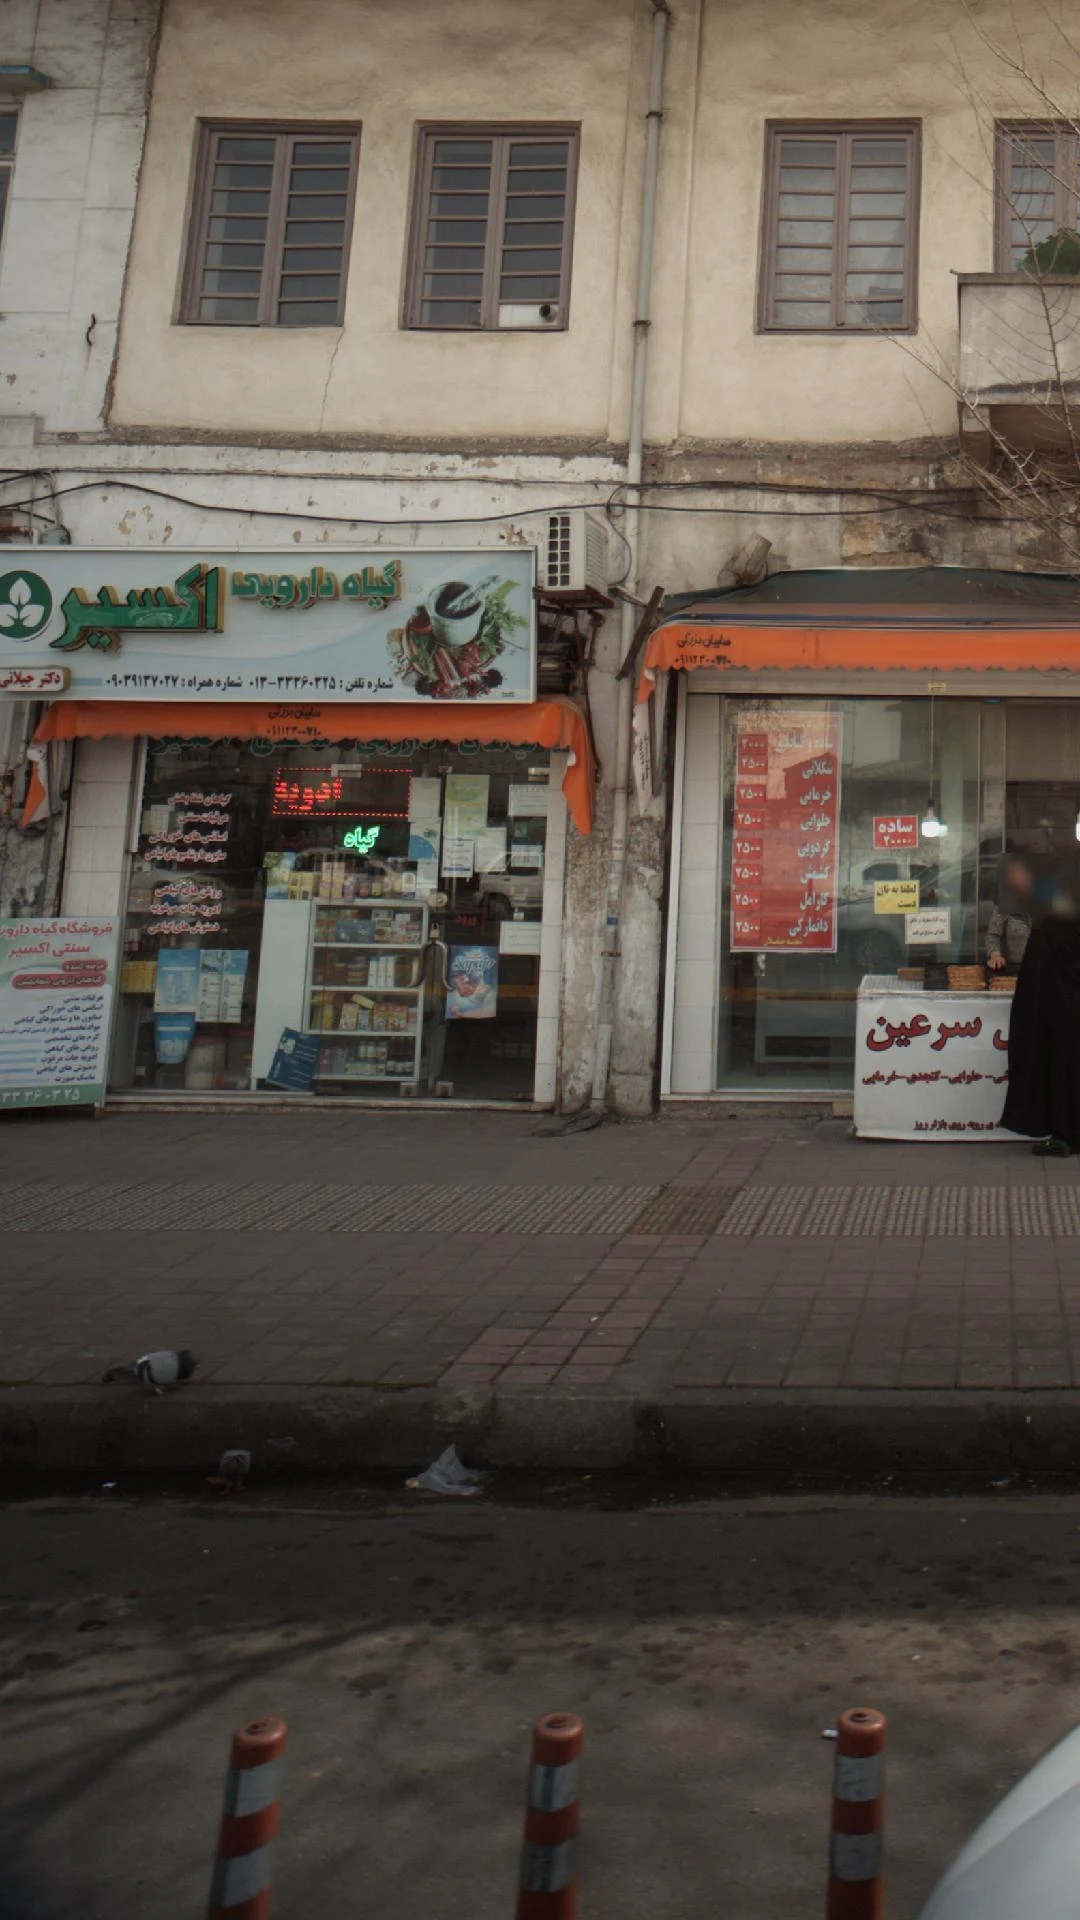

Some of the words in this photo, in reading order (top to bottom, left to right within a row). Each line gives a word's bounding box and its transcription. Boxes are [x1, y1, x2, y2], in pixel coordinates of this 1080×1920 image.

[231, 566, 340, 610] دارویی
[341, 560, 402, 610] گیاه
[49, 563, 225, 652] اکسیر
[38, 671, 61, 689] دکتر
[187, 675, 214, 691] همراه
[215, 674, 242, 692] شماره
[345, 676, 366, 692] تلفن
[367, 676, 394, 693] شماره
[742, 756, 765, 769] ۲۵۰۰
[740, 788, 763, 800] ۲۵۰۰
[799, 786, 833, 806] خرمایی
[737, 813, 761, 825] ۲۵۰۰
[799, 812, 831, 832] حلوایی
[878, 818, 913, 833] ساده
[343, 825, 380, 854] گیاه
[736, 842, 760, 853] ۲۵۰۰
[735, 867, 760, 879] ۲۵۰۰
[735, 894, 758, 906] ۲۵۰۰
[32, 921, 59, 935] گیاه
[60, 921, 113, 936] فروشگاه
[735, 921, 760, 933] ۲۵۰۰
[8, 941, 50, 960] اکسیر
[52, 942, 91, 957] سنتی
[866, 1014, 982, 1051] سرعین
